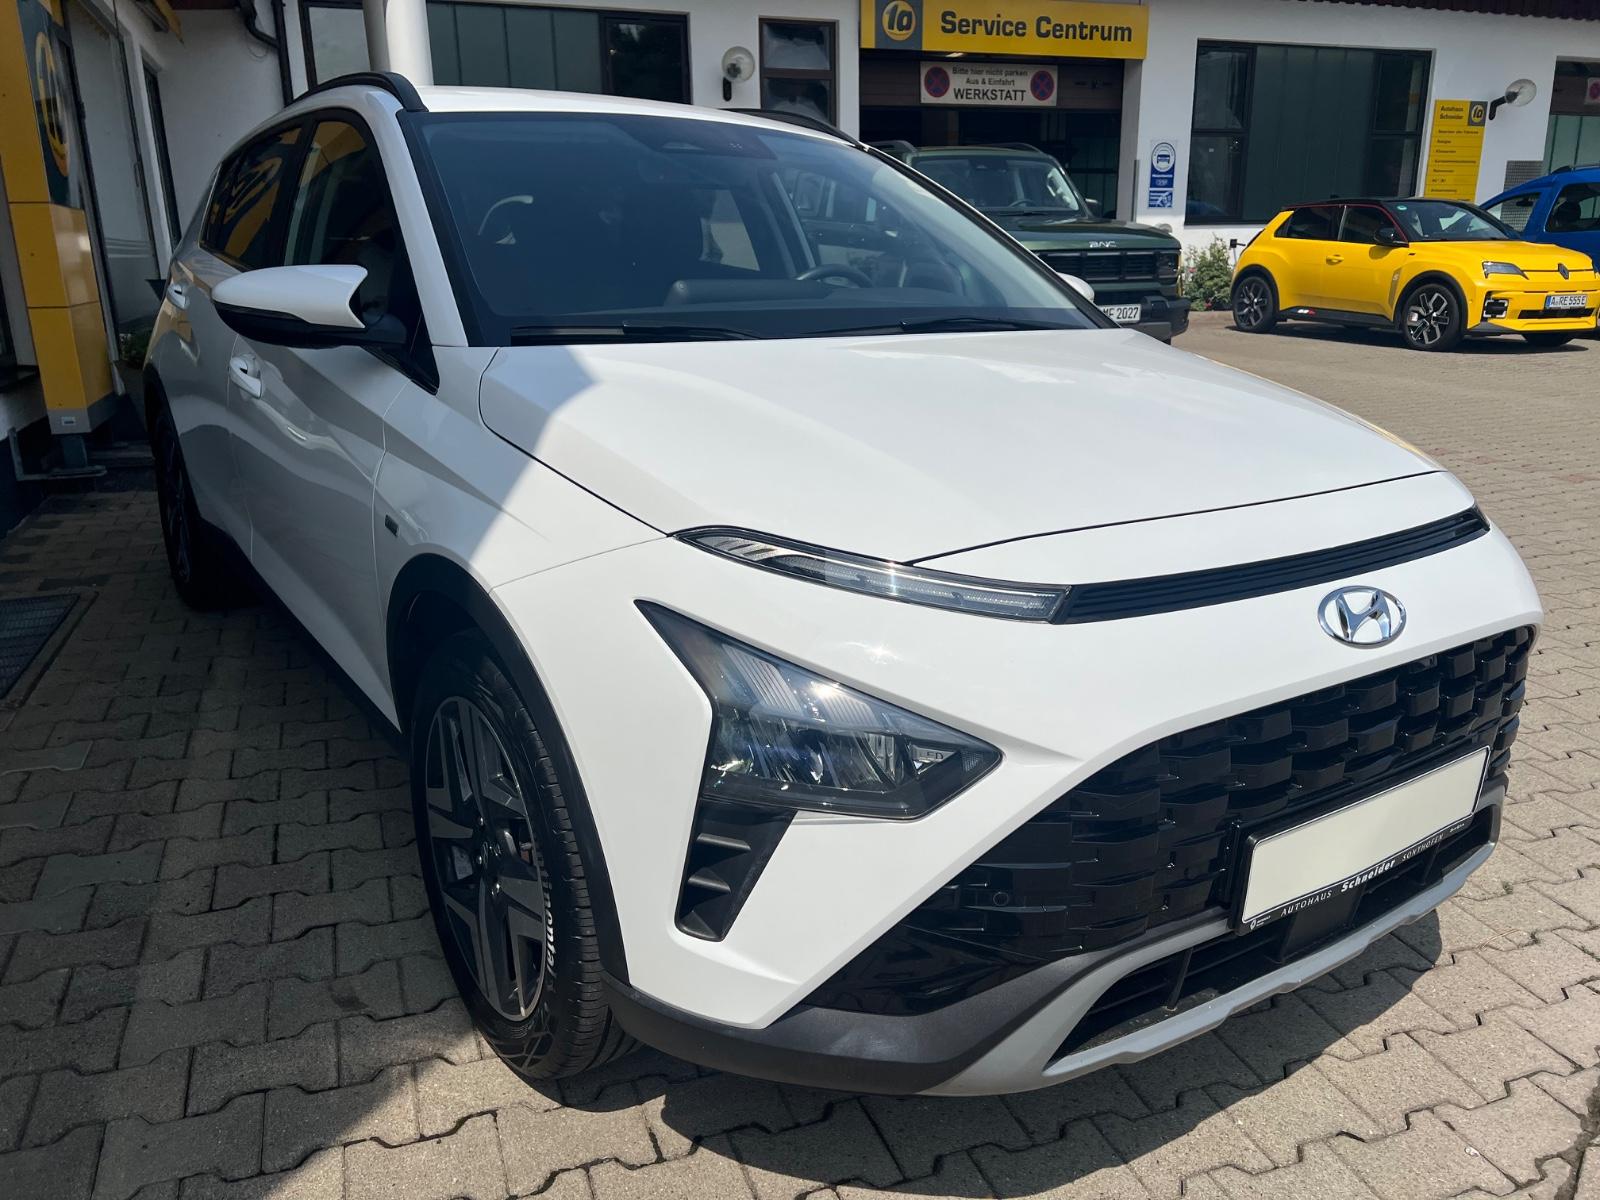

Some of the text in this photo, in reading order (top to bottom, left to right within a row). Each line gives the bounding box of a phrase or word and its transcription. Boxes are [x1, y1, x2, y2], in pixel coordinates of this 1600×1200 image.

[886, 4, 913, 31] 1a
[941, 10, 1133, 42] Service Centrum
[952, 66, 1028, 77] Bitte hier nicht parken
[988, 78, 1015, 86] Einfahrt
[953, 87, 1026, 102] WERKSTATT
[1116, 306, 1139, 320] 2027
[1280, 833, 1444, 917] AUTOHAUS Schneider SONTHOFEN
